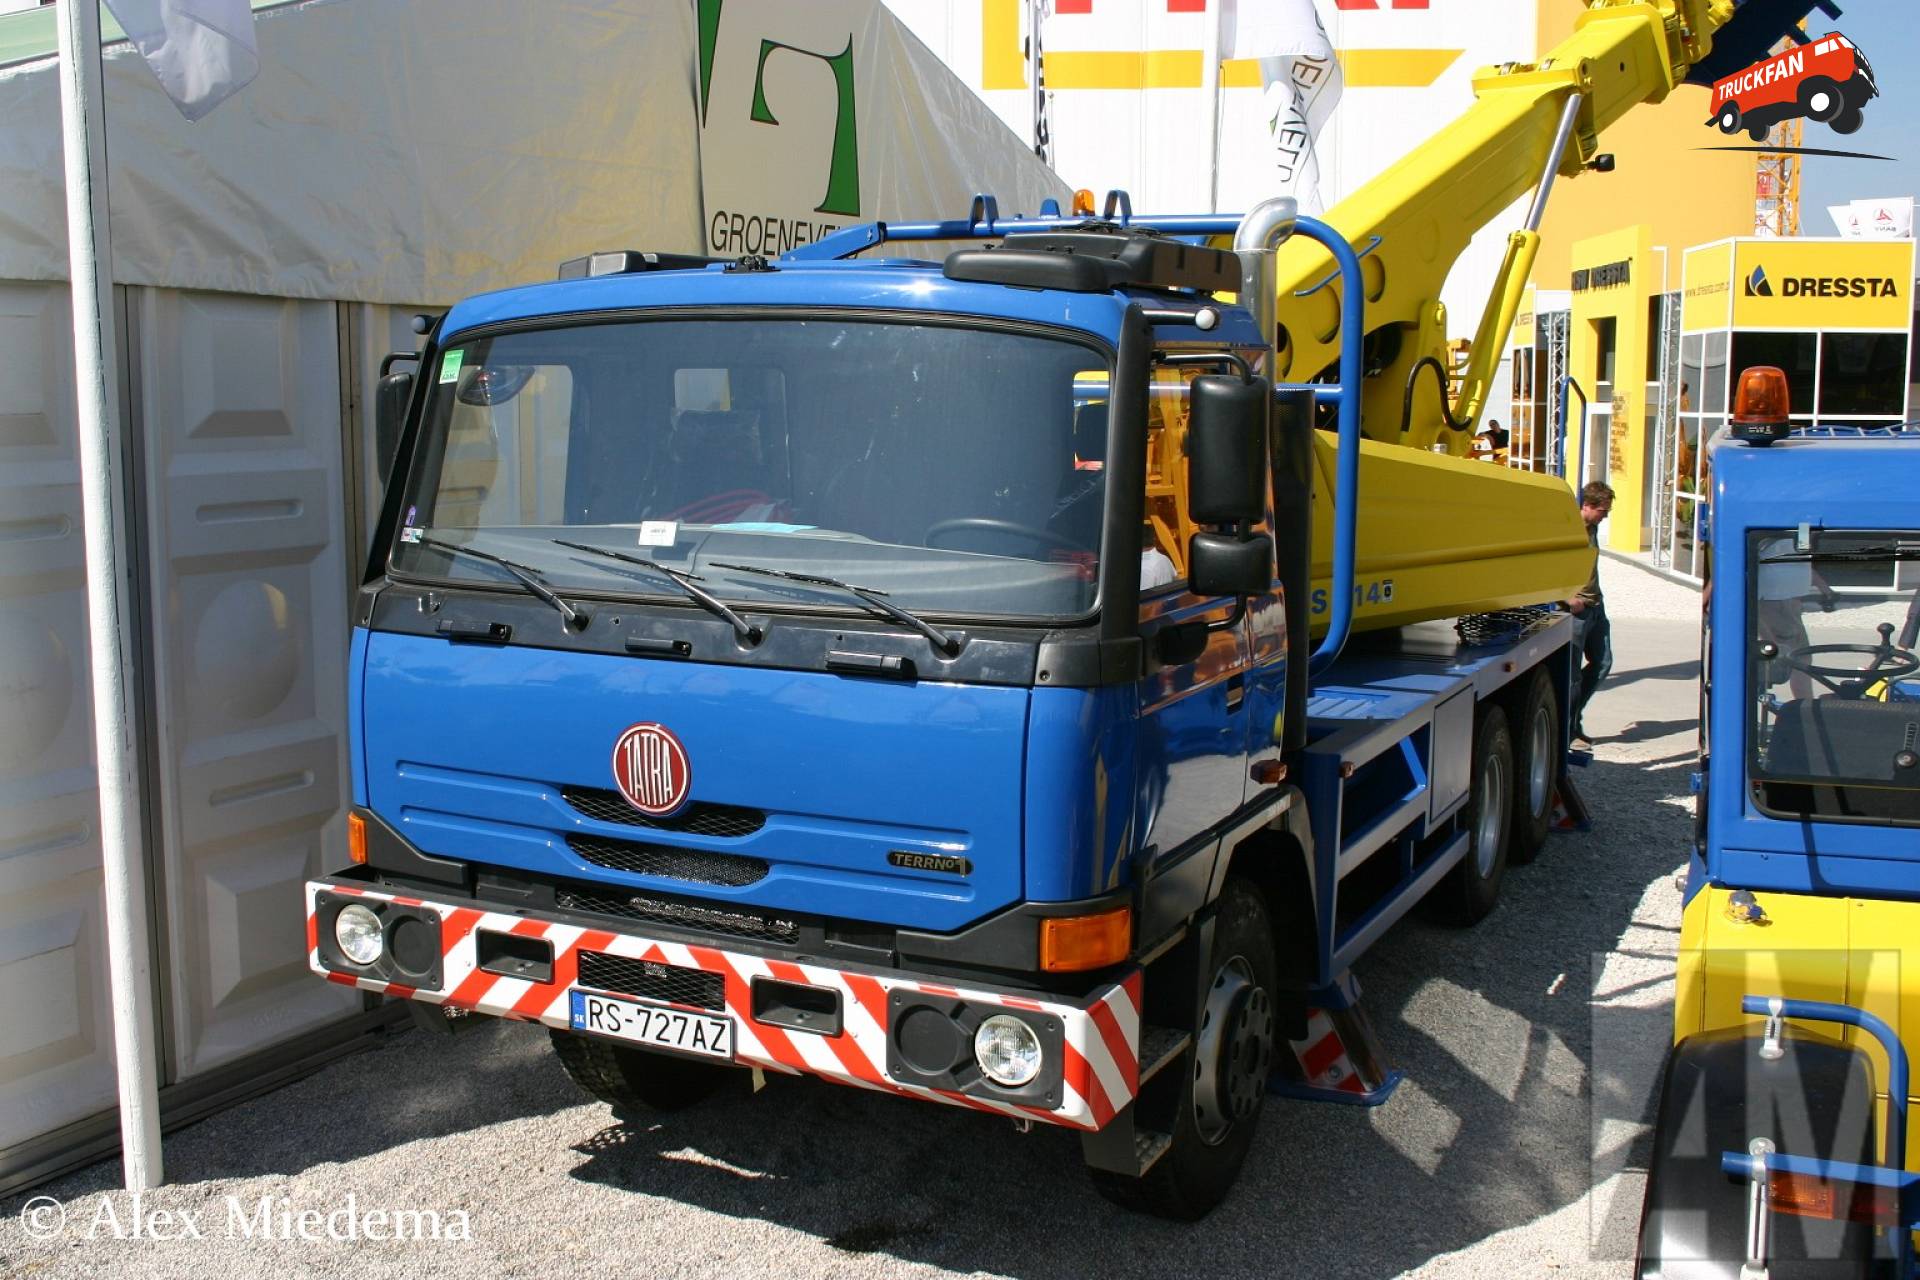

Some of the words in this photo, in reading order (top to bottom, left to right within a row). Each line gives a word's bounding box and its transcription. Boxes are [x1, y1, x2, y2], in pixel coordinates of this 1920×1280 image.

[1782, 277, 1899, 298] DRESSTA
[624, 732, 674, 806] TATRA
[574, 1013, 585, 1024] SK
[588, 998, 727, 1053] RS-727AZ
